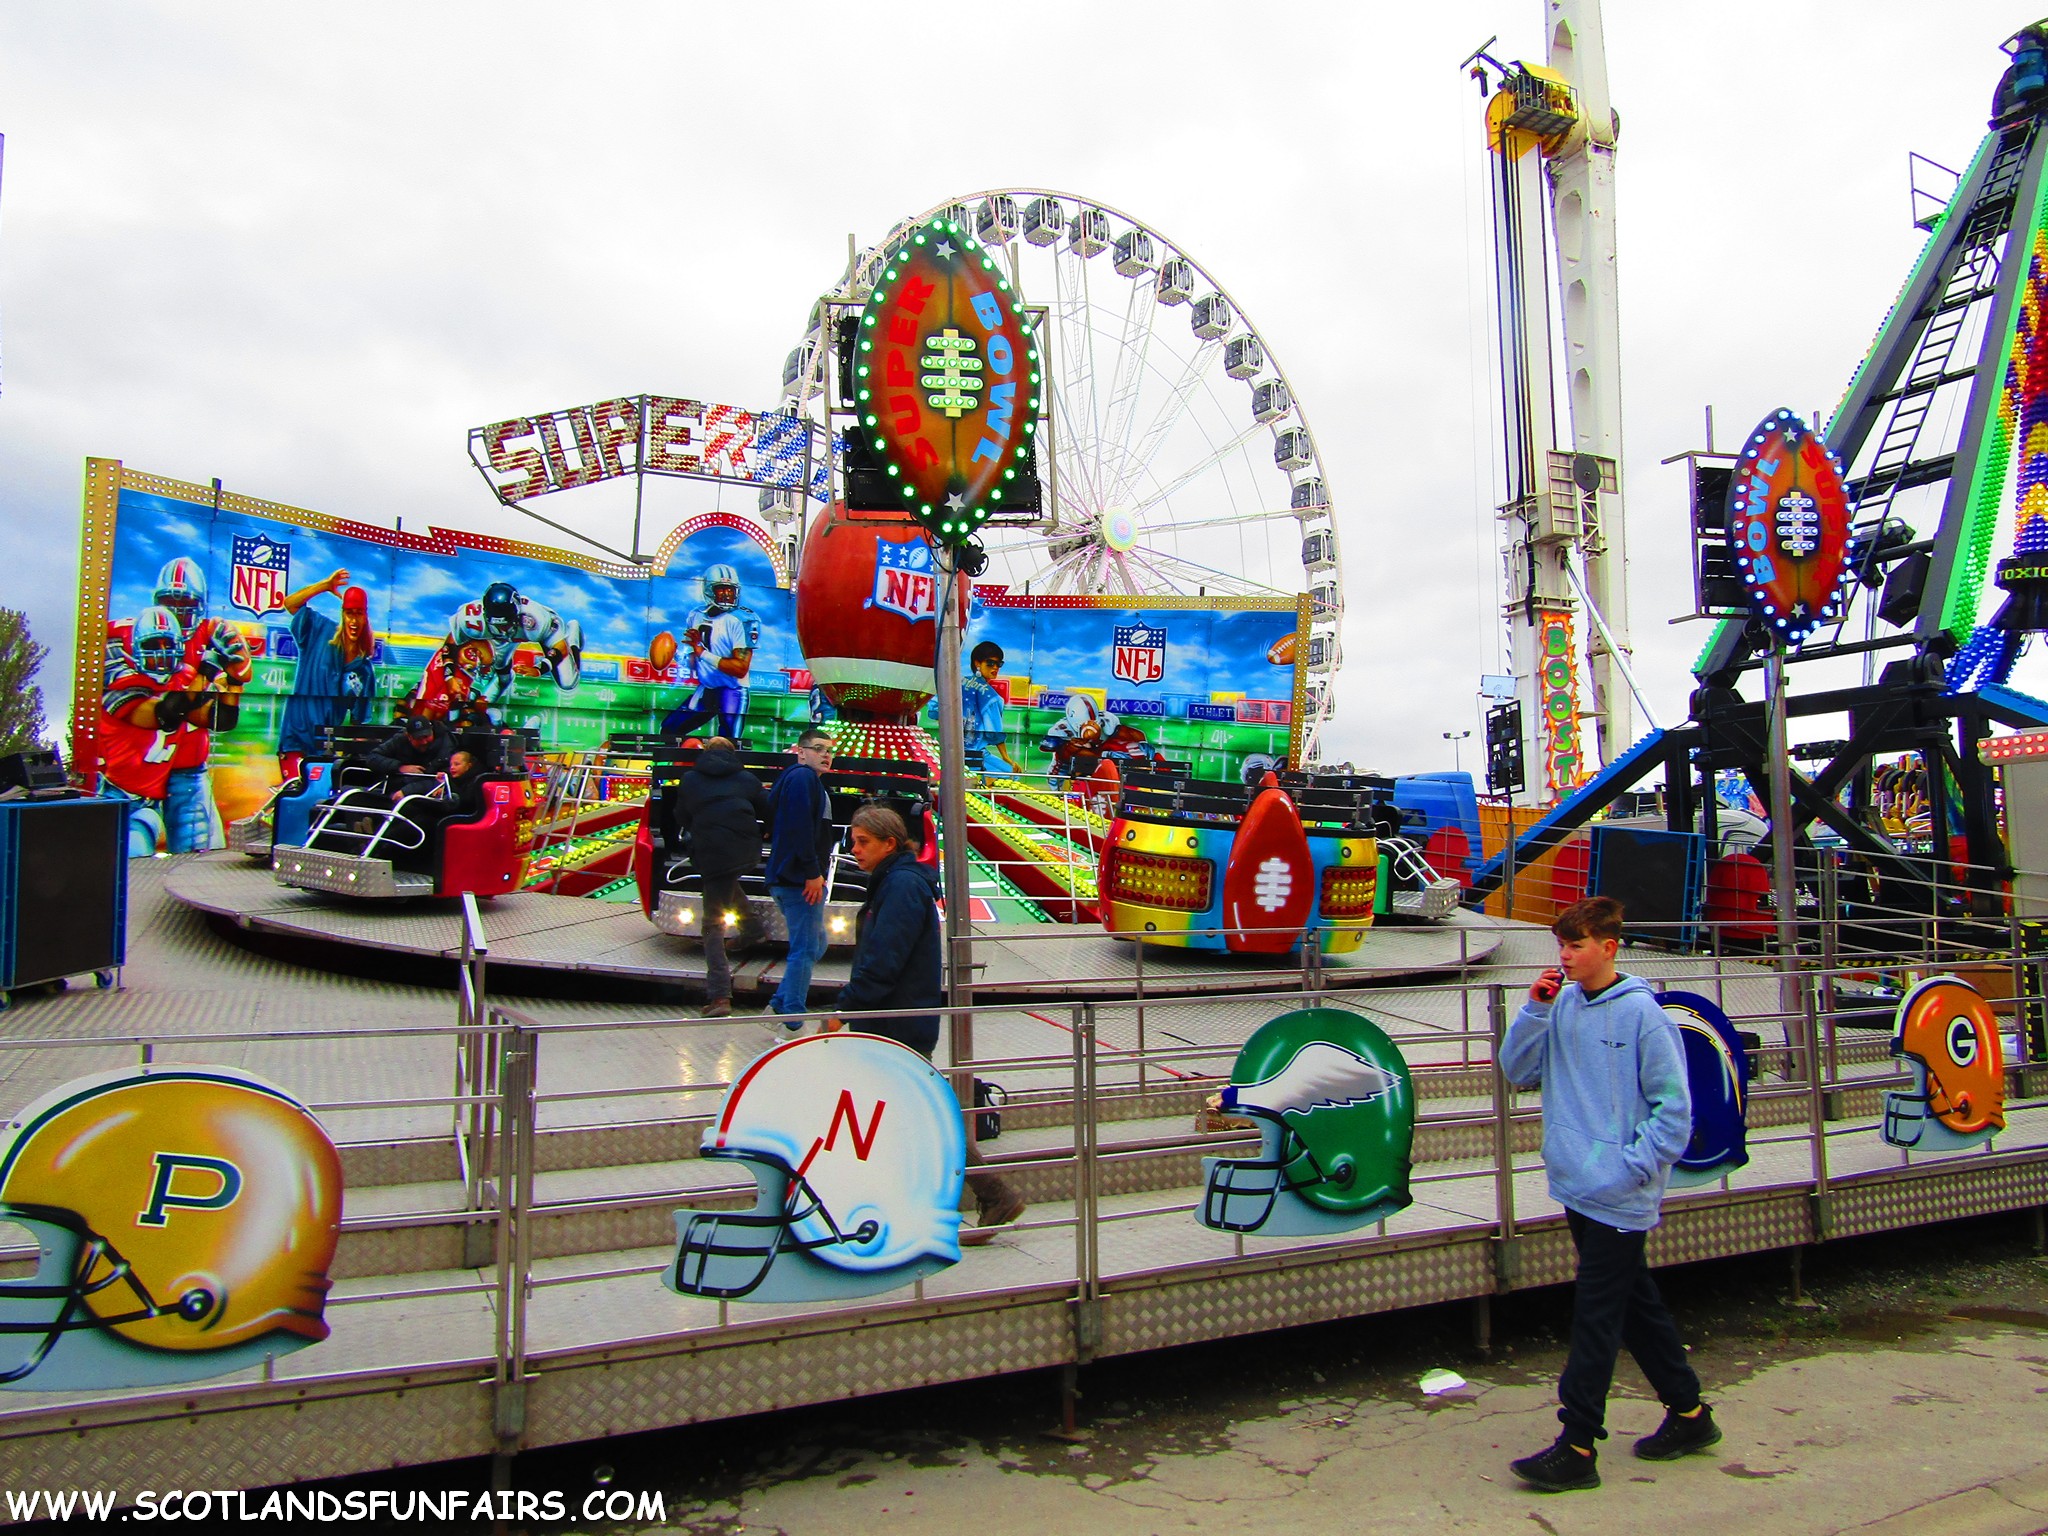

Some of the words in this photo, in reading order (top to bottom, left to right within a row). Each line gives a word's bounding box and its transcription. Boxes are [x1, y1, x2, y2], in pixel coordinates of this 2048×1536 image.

[887, 275, 939, 471] SUPER
[970, 291, 1017, 463] BOWL
[484, 396, 753, 501] SUPER
[1746, 458, 1780, 585] BOWL
[1801, 445, 1840, 588] SUPER
[234, 565, 284, 611] NFL
[882, 569, 935, 615] NF
[1116, 647, 1161, 681] NFL
[1109, 700, 1129, 712] AK
[1133, 701, 1163, 714] 2001
[1947, 1015, 1978, 1067] G
[823, 1089, 887, 1162] N
[137, 1151, 243, 1228] P
